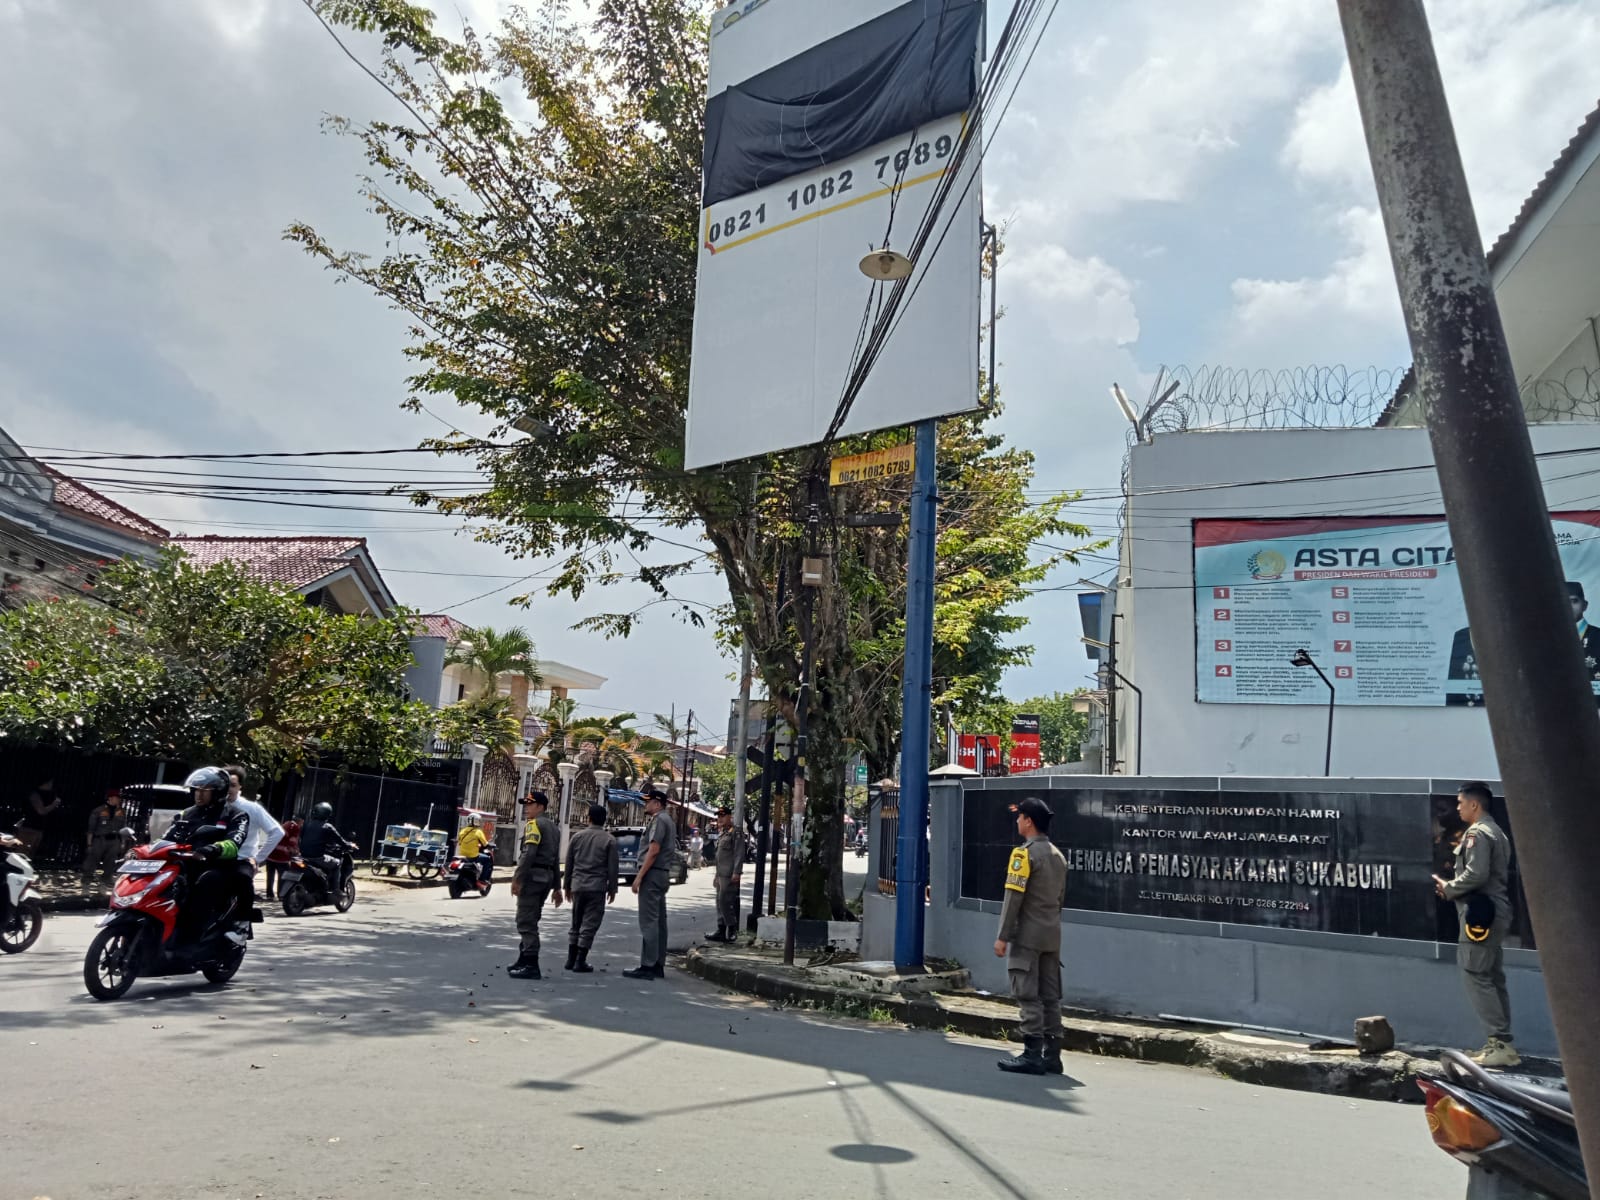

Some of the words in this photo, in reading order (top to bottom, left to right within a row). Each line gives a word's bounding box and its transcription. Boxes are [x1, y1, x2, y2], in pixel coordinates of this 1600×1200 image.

[709, 203, 767, 242] 0821
[787, 170, 853, 211] 1082
[839, 469, 860, 483] 0821
[863, 464, 884, 478] 1082
[887, 460, 910, 474] 6789
[1294, 548, 1380, 567] ASTA
[1302, 571, 1341, 579] PRESIDEN
[1390, 570, 1429, 578] PRESIDEN
[1218, 589, 1225, 598] 1
[1335, 588, 1346, 597] 5
[1217, 611, 1227, 619] 2
[1335, 613, 1347, 621] 6
[1217, 641, 1228, 650] 3
[1337, 642, 1347, 650] 7
[1218, 666, 1229, 675] 4
[1338, 668, 1350, 677] 8
[1114, 804, 1205, 816] KEMENTERIAN
[1206, 805, 1255, 817] HUKUM
[1288, 808, 1322, 819] HAM
[1325, 809, 1340, 819] RI
[1122, 828, 1176, 839] KANTOR
[1178, 829, 1237, 841] WILAYAH
[1067, 848, 1134, 874] LEMBAGA
[1138, 852, 1290, 883] PEMASYARAKATAN
[1295, 860, 1393, 890] SUKABUMI
